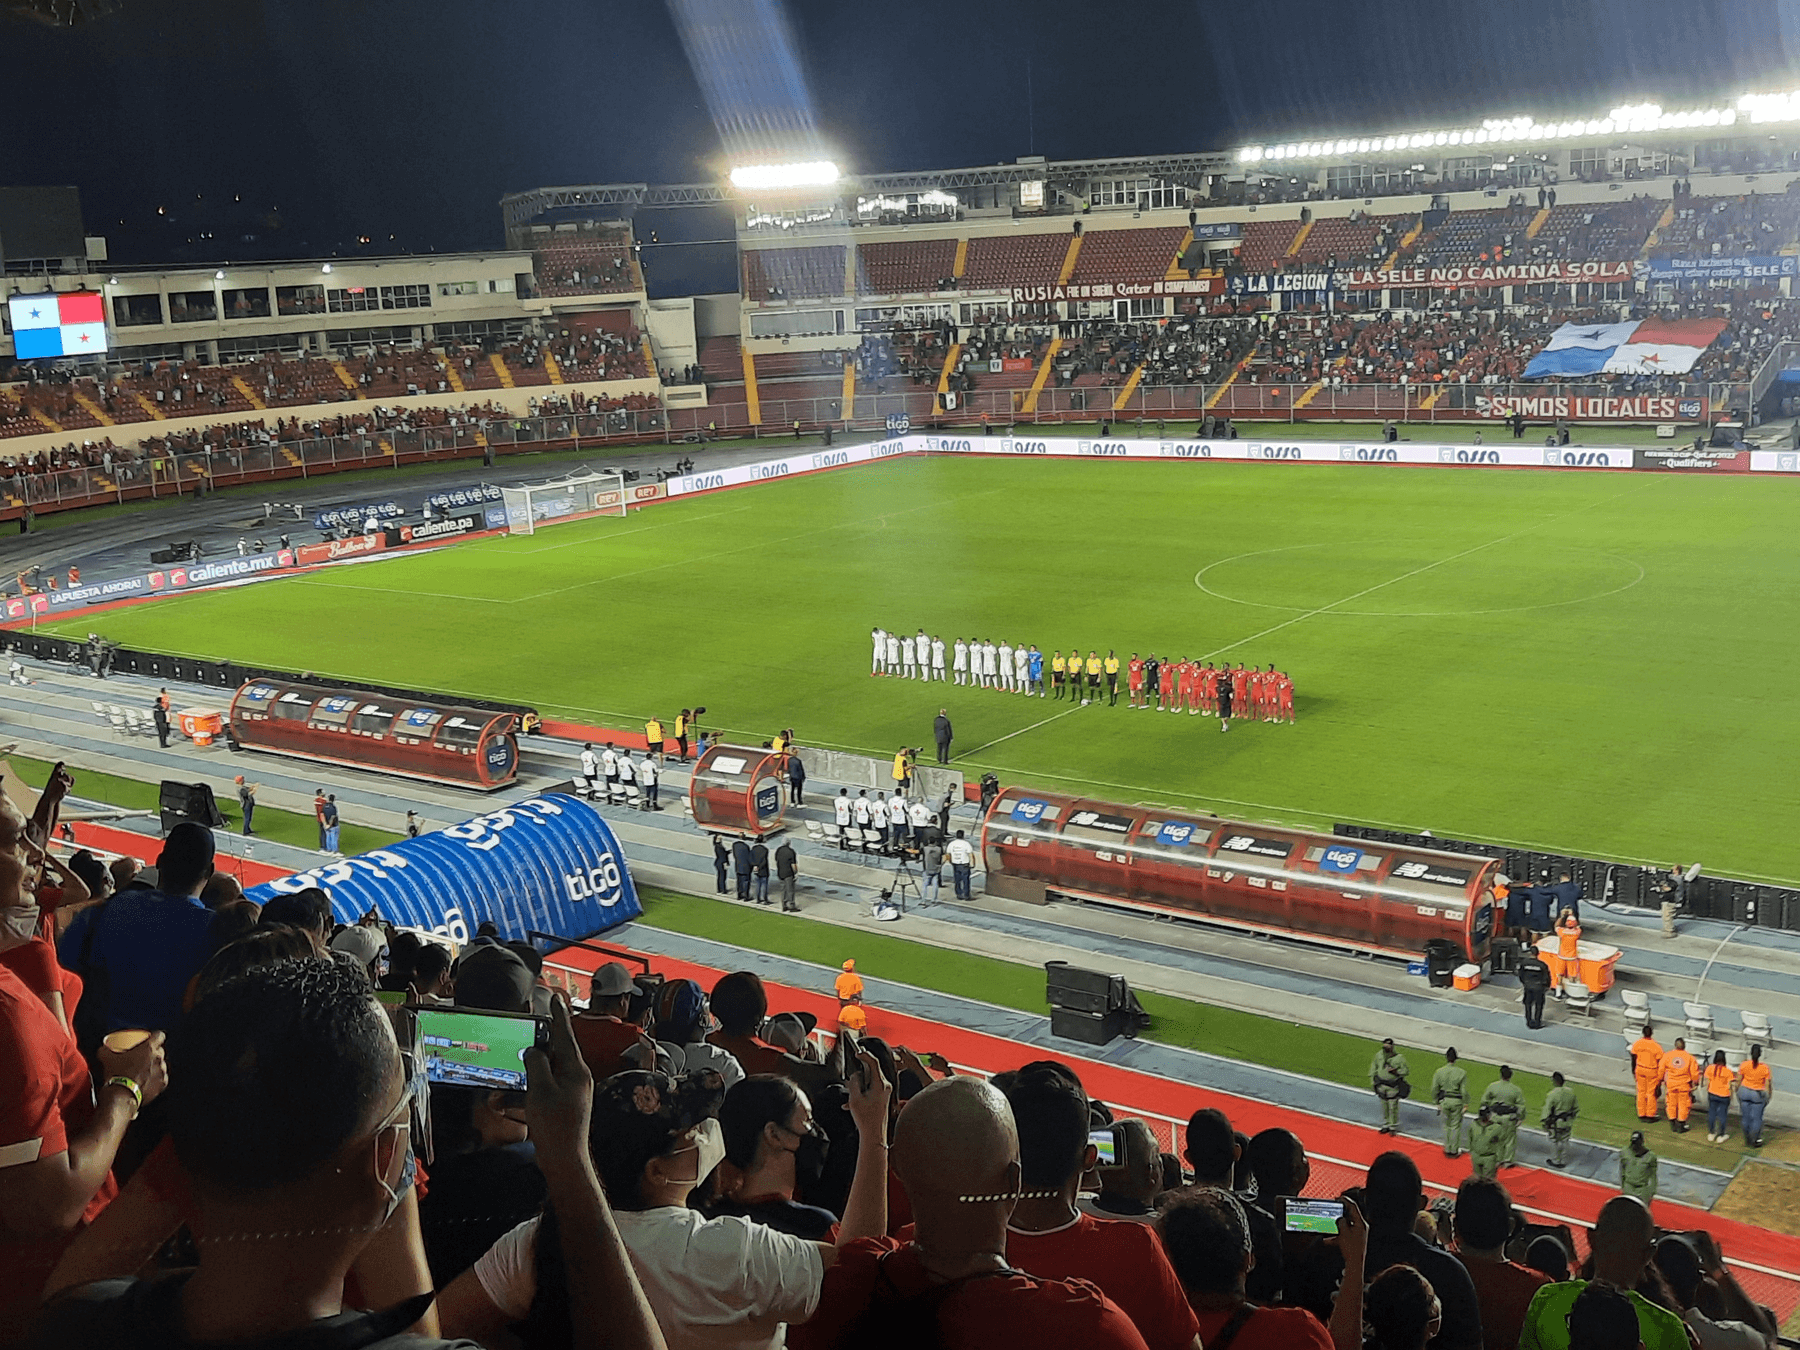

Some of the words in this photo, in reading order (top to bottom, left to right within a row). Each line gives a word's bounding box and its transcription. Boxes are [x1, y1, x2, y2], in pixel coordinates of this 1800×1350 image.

[1348, 271, 1375, 284] LA
[1376, 269, 1426, 283] SELE
[1430, 268, 1463, 281] NO
[1467, 264, 1562, 280] CAMINA
[1566, 261, 1630, 277] SOLA
[1743, 265, 1779, 277] SELE
[1247, 275, 1269, 292] LA
[1273, 274, 1329, 291] LEGION
[1013, 286, 1065, 302] RUSIA
[1116, 282, 1152, 297] Qatar
[1493, 397, 1569, 418] SOMOS
[1576, 398, 1676, 418] LOCALES
[1679, 402, 1702, 418] tigo
[886, 416, 910, 435] tigo
[880, 441, 904, 455] assa
[940, 440, 971, 452] assa
[1014, 441, 1047, 454] assa
[1092, 443, 1127, 455] assa
[1175, 444, 1211, 457] assa
[1263, 446, 1302, 459] assa
[823, 451, 848, 466] assa
[1356, 448, 1398, 461] assa
[1456, 450, 1500, 463] assa
[1563, 452, 1610, 466] assa
[762, 463, 789, 477] assa
[1666, 458, 1713, 469] Qualifiers
[695, 474, 724, 490] assa
[636, 486, 655, 498] REY
[411, 517, 474, 537] caliente.pa
[189, 556, 274, 582] caliente.mx
[51, 586, 101, 604] ¡APUESTA
[102, 579, 142, 598] AHORA!
[184, 716, 196, 733] G
[1017, 803, 1043, 819] tigo
[1163, 824, 1191, 842] tigo
[1326, 851, 1357, 869] tigo
[565, 852, 621, 907] tigo
